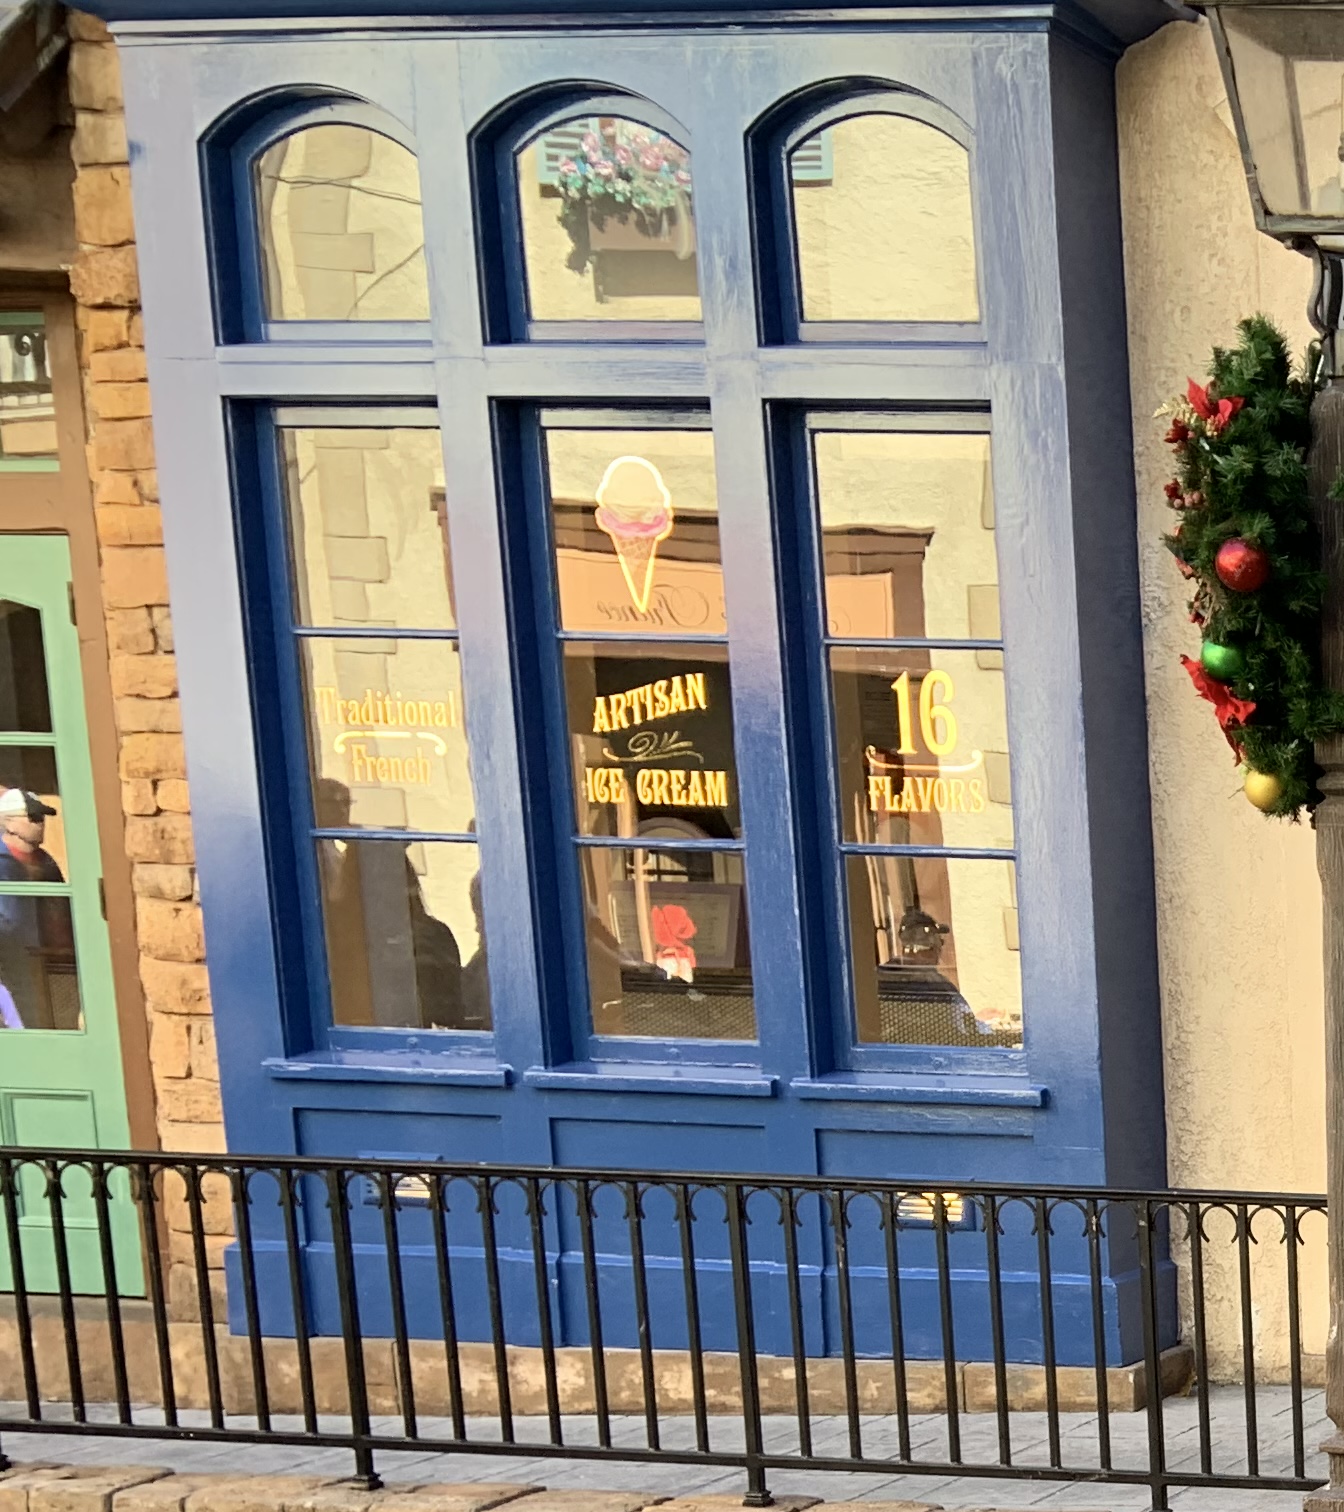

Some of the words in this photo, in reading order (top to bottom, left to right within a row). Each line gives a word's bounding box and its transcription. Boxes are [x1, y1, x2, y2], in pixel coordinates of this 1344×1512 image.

[314, 686, 458, 728] Traditional
[592, 672, 707, 732] ARTISAN
[891, 669, 957, 755] 16
[351, 743, 432, 785] French
[585, 767, 625, 803] ICE
[636, 768, 728, 807] CREAM
[868, 776, 986, 813] FLAVORS
